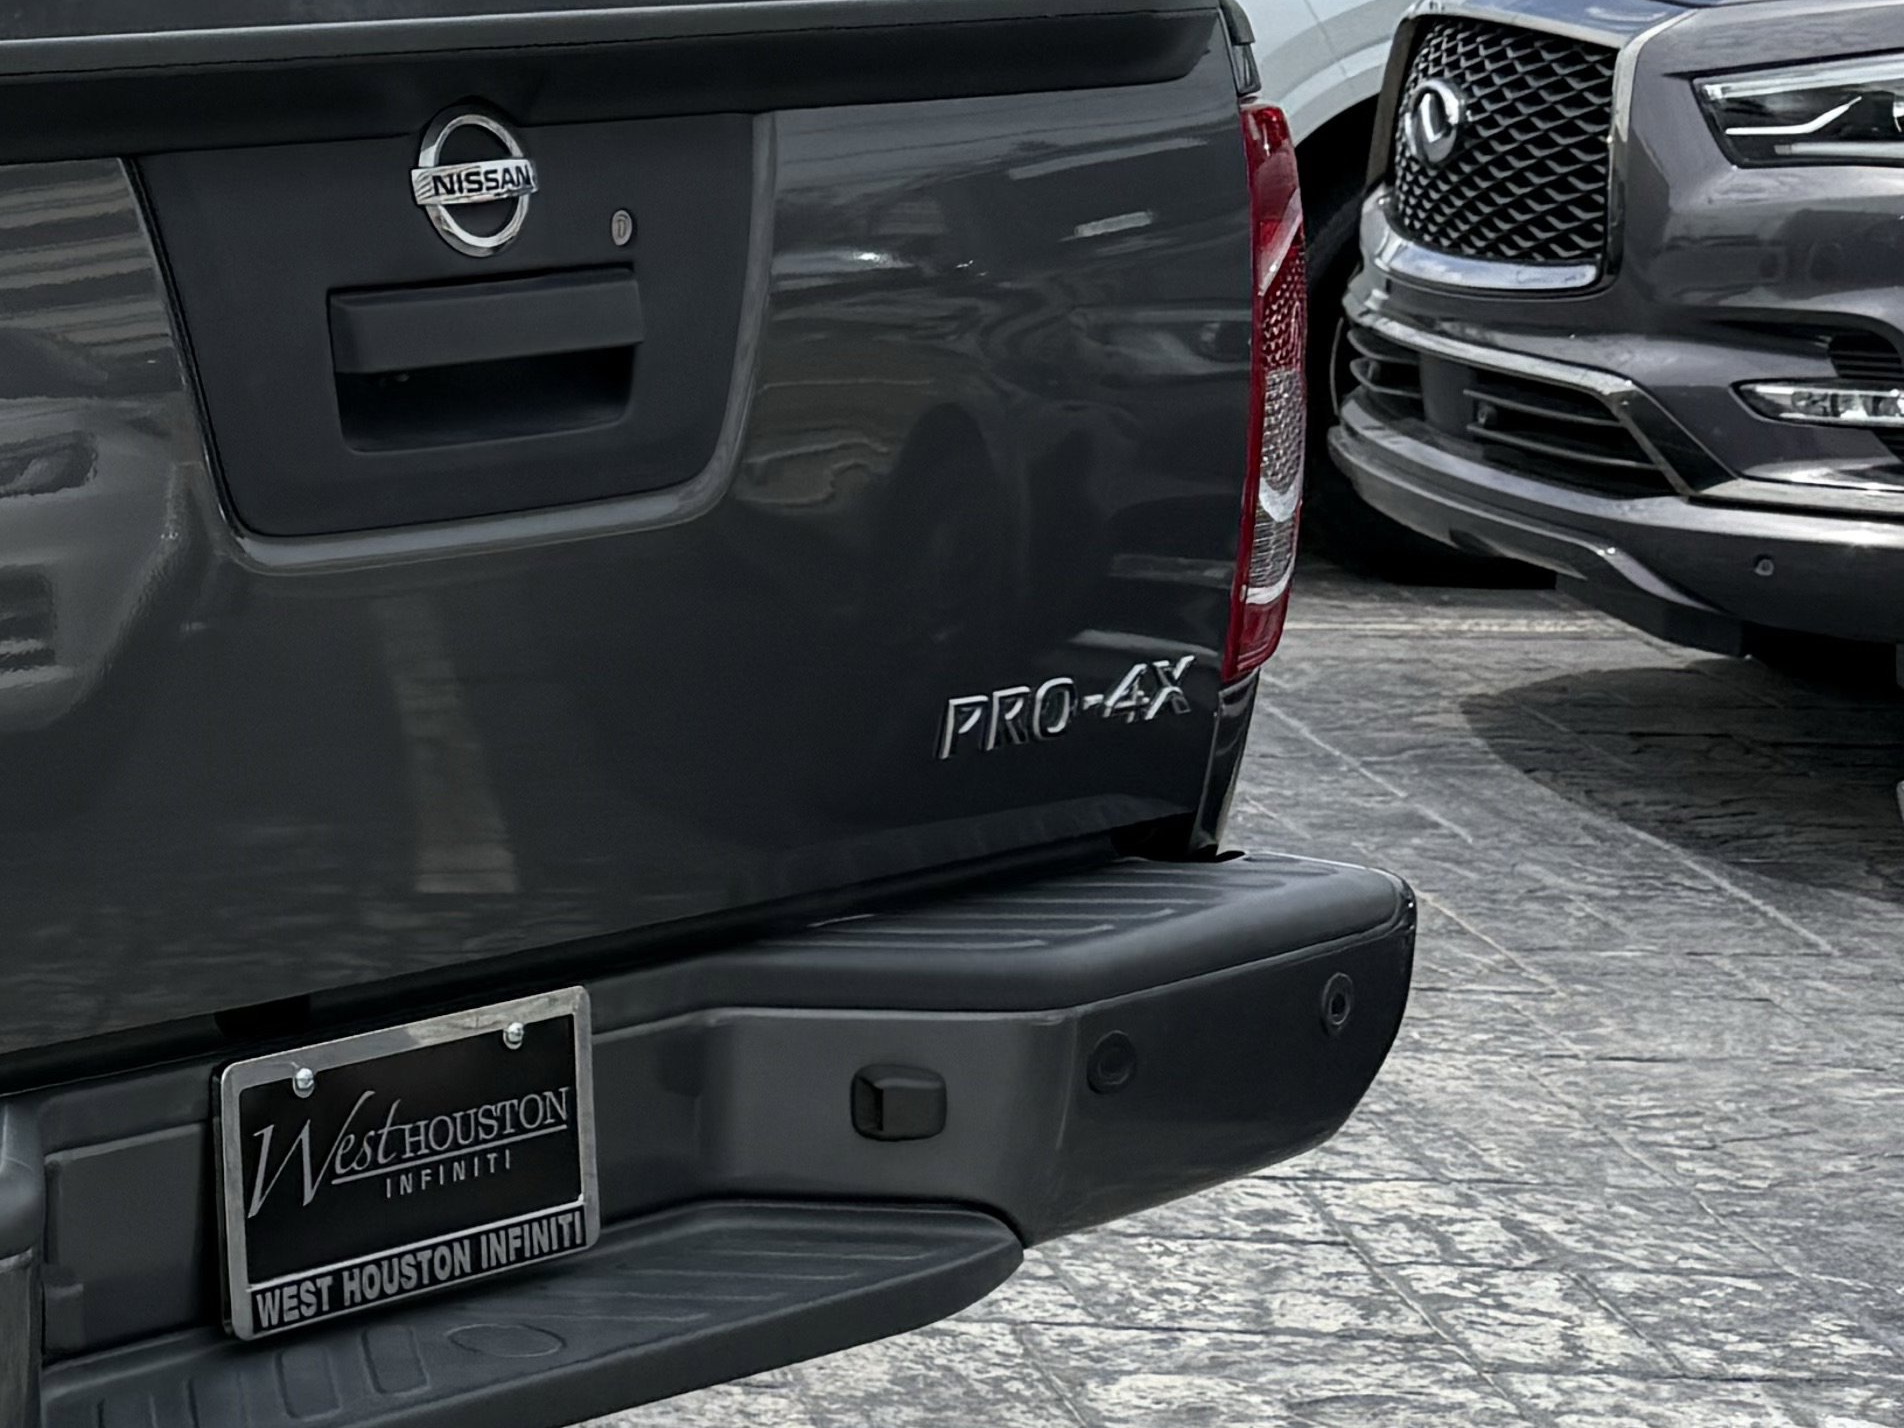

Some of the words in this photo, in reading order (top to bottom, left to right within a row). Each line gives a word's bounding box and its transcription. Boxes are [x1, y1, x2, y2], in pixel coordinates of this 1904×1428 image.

[432, 163, 532, 199] NISSAN
[937, 654, 1196, 760] PRO-4X
[385, 1148, 512, 1199] INFINITI
[255, 1279, 333, 1329] WEST
[342, 1238, 473, 1308] HOUSTON
[480, 1210, 585, 1270] INFINITI
